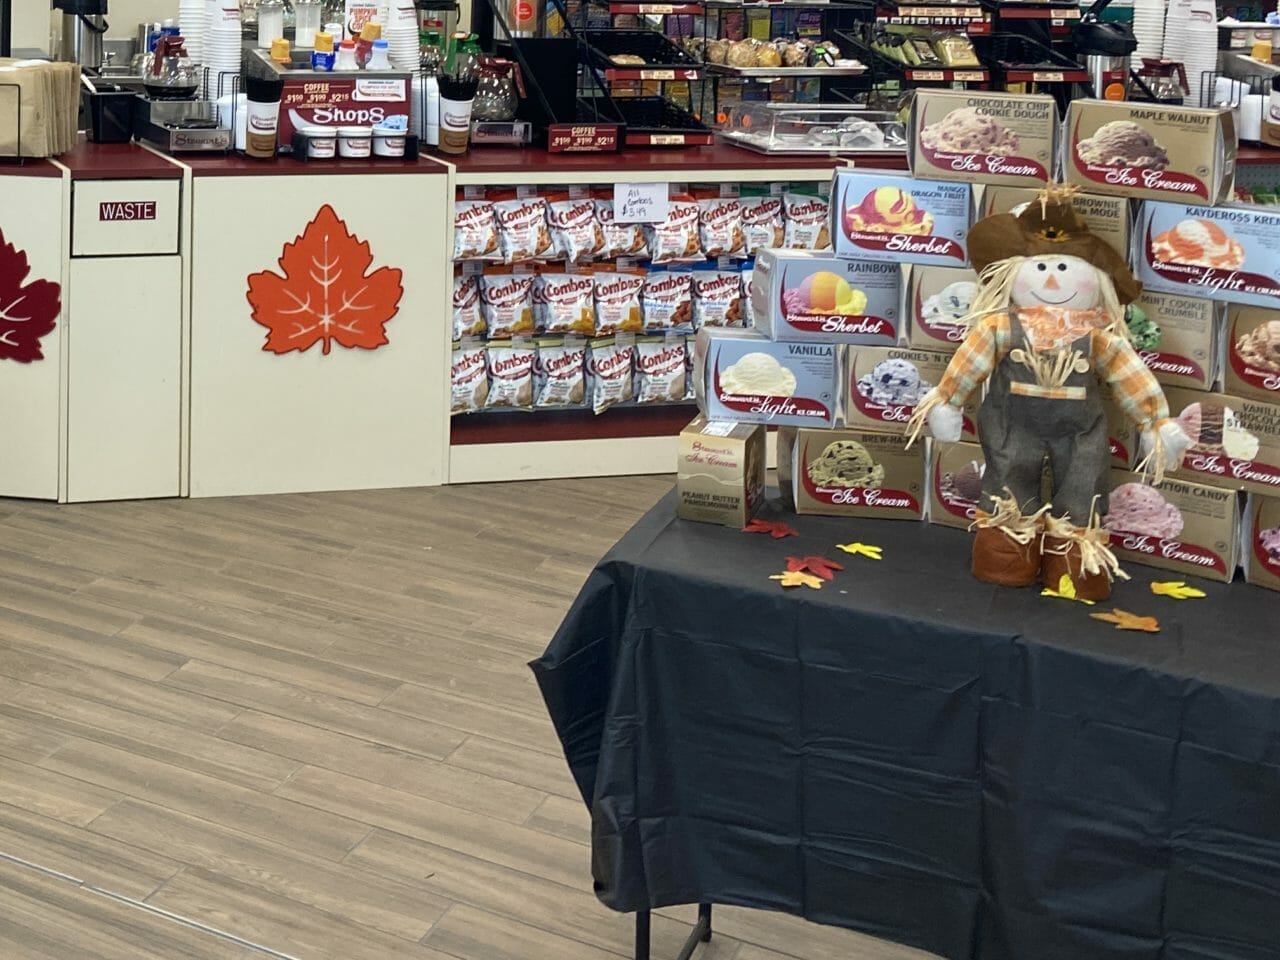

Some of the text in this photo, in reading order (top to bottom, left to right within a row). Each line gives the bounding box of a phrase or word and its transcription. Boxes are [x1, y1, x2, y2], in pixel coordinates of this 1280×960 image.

[967, 98, 1049, 110] CHOCOLATE CHIP
[975, 108, 1049, 119] COOKIE DOUGH
[1130, 110, 1211, 125] MAPLE WALNUT
[951, 155, 982, 171] Ice
[985, 155, 1038, 176] Cream
[1105, 167, 1197, 192] Ice Cream
[911, 190, 942, 198] DRAGON
[937, 185, 967, 193] MANGO
[102, 203, 154, 219] WASTE
[501, 199, 546, 223] Combos
[558, 200, 593, 223] Combos
[701, 200, 739, 221] Combos
[742, 198, 779, 220] Combos
[789, 199, 828, 216] Combos
[1072, 197, 1120, 208] BROWNIE
[1090, 208, 1120, 218] MODE
[1185, 207, 1251, 223] KAYDEROSS
[886, 235, 952, 254] Sherbet
[847, 263, 898, 274] RAINBOW
[489, 276, 534, 300] Combos
[547, 278, 592, 297] Combos
[595, 278, 640, 297] Combos
[645, 274, 690, 293] Combos
[697, 274, 738, 292] Combos
[1188, 267, 1245, 295] Light
[1141, 295, 1207, 310] MINT COOKIE
[1158, 307, 1207, 319] CRUMBLE
[821, 316, 883, 334] Sherbet
[597, 347, 633, 372] Combos
[642, 346, 683, 369] Combos
[788, 345, 832, 356] VANILLA
[888, 350, 928, 361] COOKIES
[495, 352, 533, 373] Combos
[546, 350, 584, 372] Combos
[1139, 351, 1194, 375] Cream
[751, 395, 797, 420] Light
[882, 406, 911, 421] Ice
[705, 455, 737, 468] Cream
[1192, 456, 1225, 474] Ice
[682, 491, 740, 503] PEANUT BUTTER
[832, 489, 910, 508] Ice Cream
[1193, 487, 1229, 502] CANDY
[1123, 537, 1216, 566] Ice Cream
